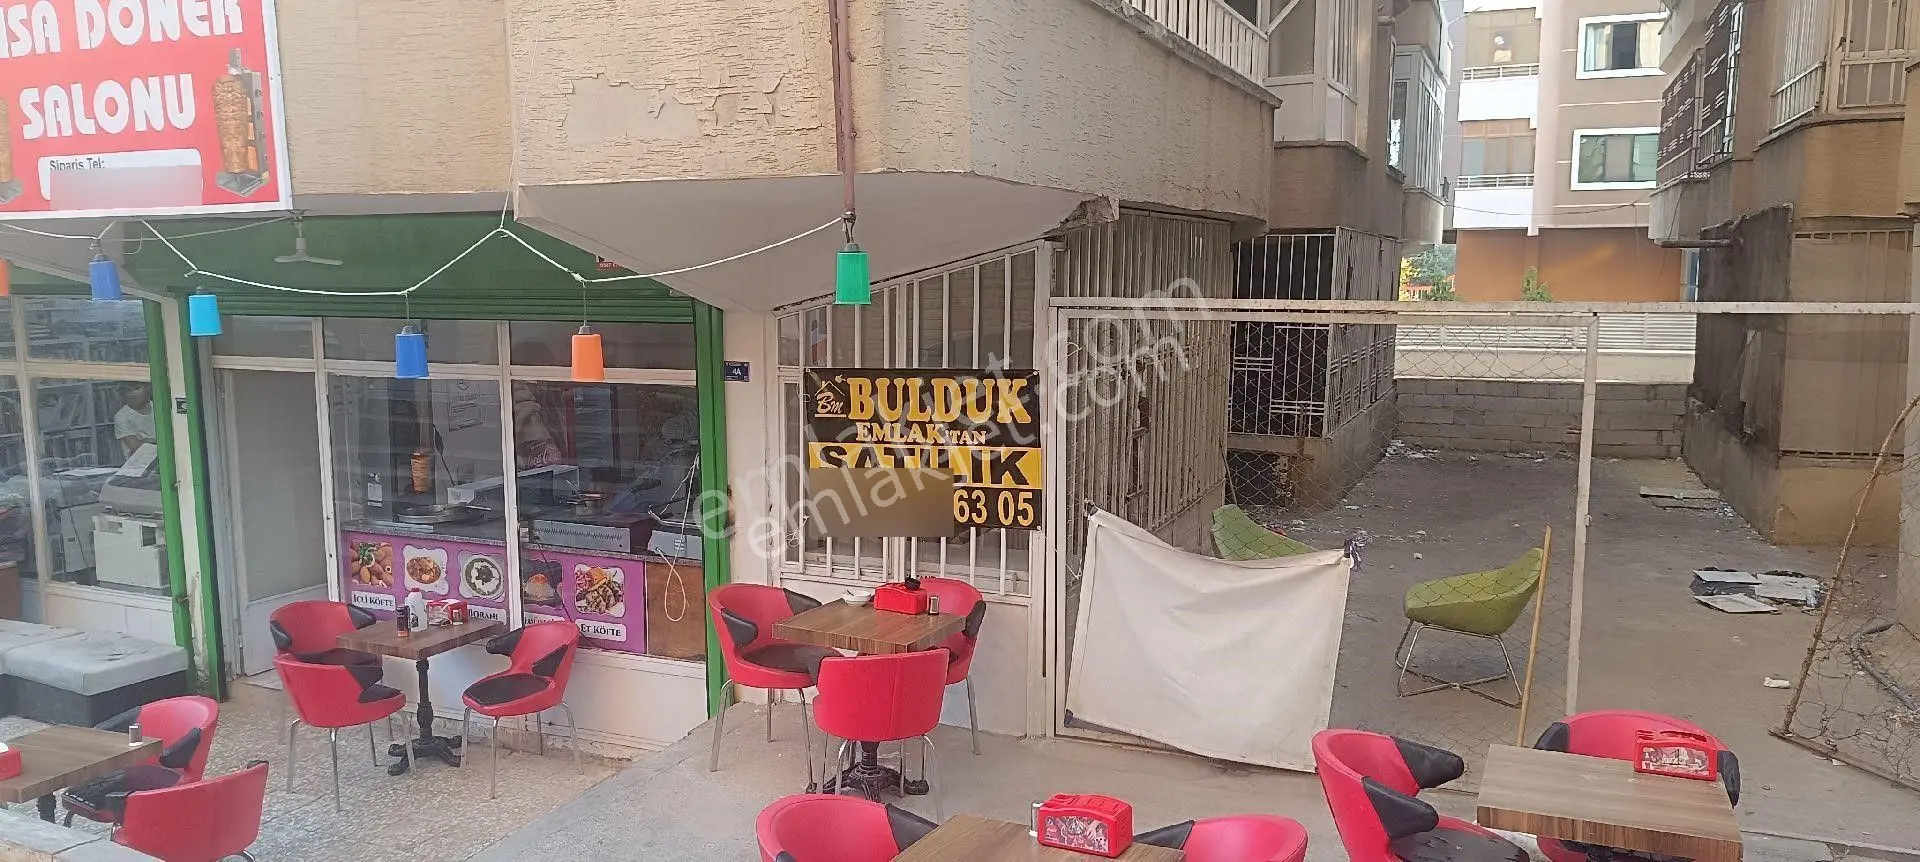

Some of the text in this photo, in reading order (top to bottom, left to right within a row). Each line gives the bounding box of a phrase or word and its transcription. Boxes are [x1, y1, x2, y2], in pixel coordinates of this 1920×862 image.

[19, 73, 195, 140] SALONU
[732, 367, 742, 376] 4A
[848, 377, 1031, 424] BULDUK
[953, 489, 1034, 527] 63 05
